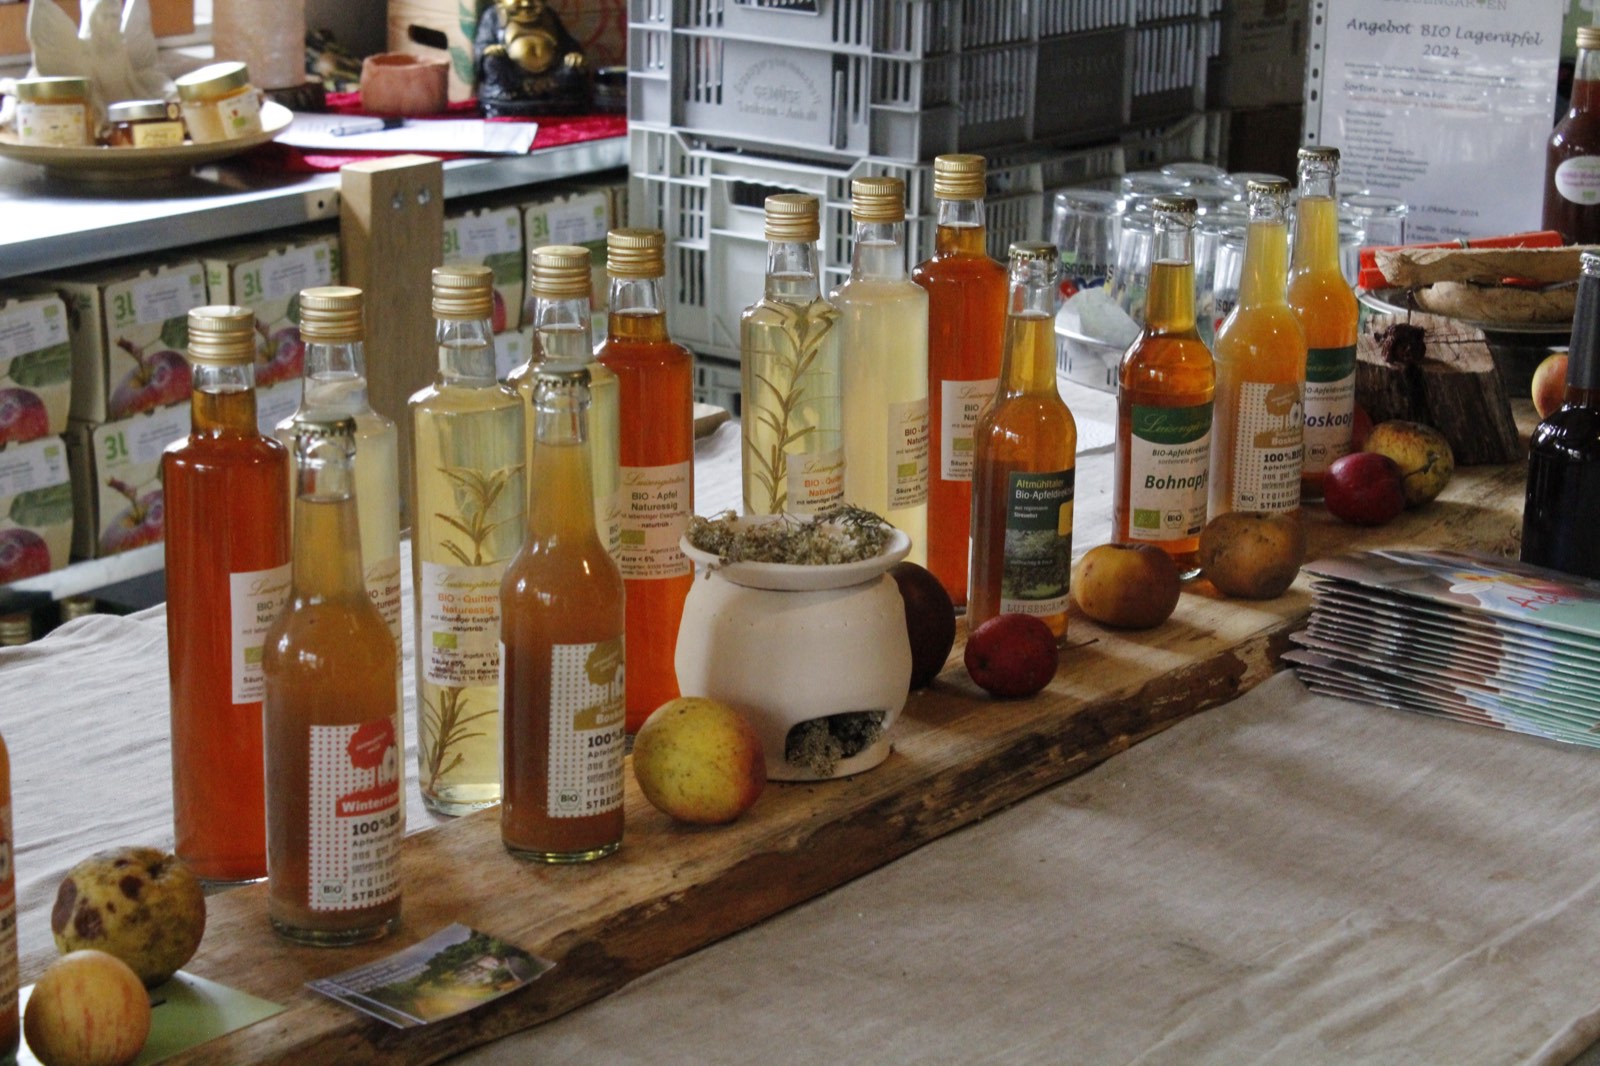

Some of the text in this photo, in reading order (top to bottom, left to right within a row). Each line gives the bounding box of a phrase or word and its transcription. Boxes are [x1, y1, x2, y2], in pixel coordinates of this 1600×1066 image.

[1347, 18, 1543, 47] Angebot BIO Lageräpfel
[1422, 44, 1460, 58] 2024
[631, 491, 649, 501] BIO
[657, 489, 678, 502] Apfel
[631, 501, 678, 512] Naturessig
[442, 604, 494, 616] Naturessig
